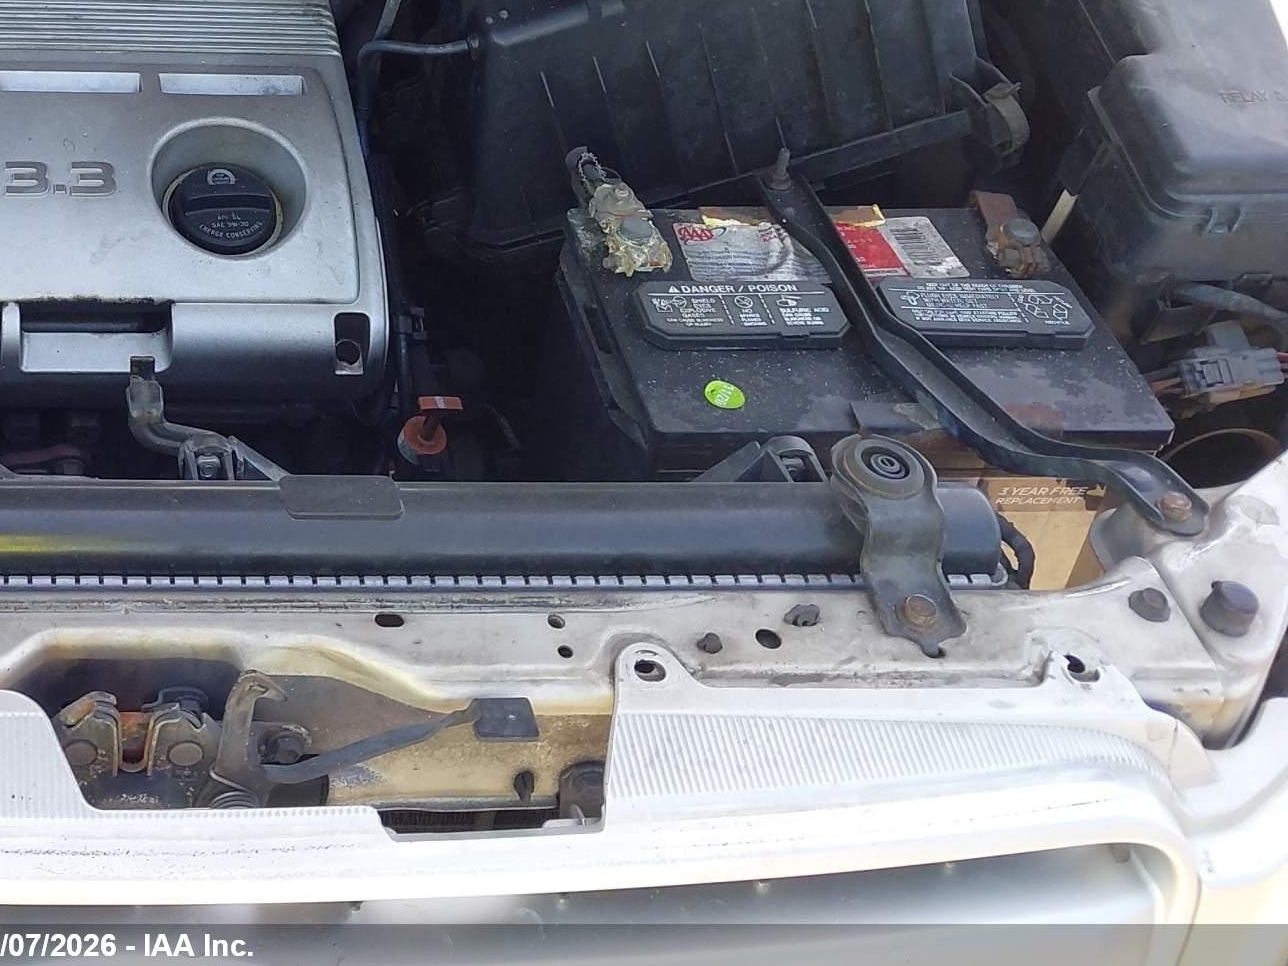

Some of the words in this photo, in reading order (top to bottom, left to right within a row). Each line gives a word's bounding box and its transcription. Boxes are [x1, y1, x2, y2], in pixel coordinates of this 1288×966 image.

[5, 160, 118, 199] 3.3
[199, 224, 224, 237] ENERGY
[678, 226, 713, 241] AAA
[681, 284, 735, 294] DANGER
[737, 284, 744, 294] /
[748, 283, 799, 293] POISON
[999, 487, 1009, 496] 3
[1012, 486, 1048, 496] YEAR
[1050, 486, 1089, 496] FREE
[994, 496, 1081, 505] REPLACEMENT
